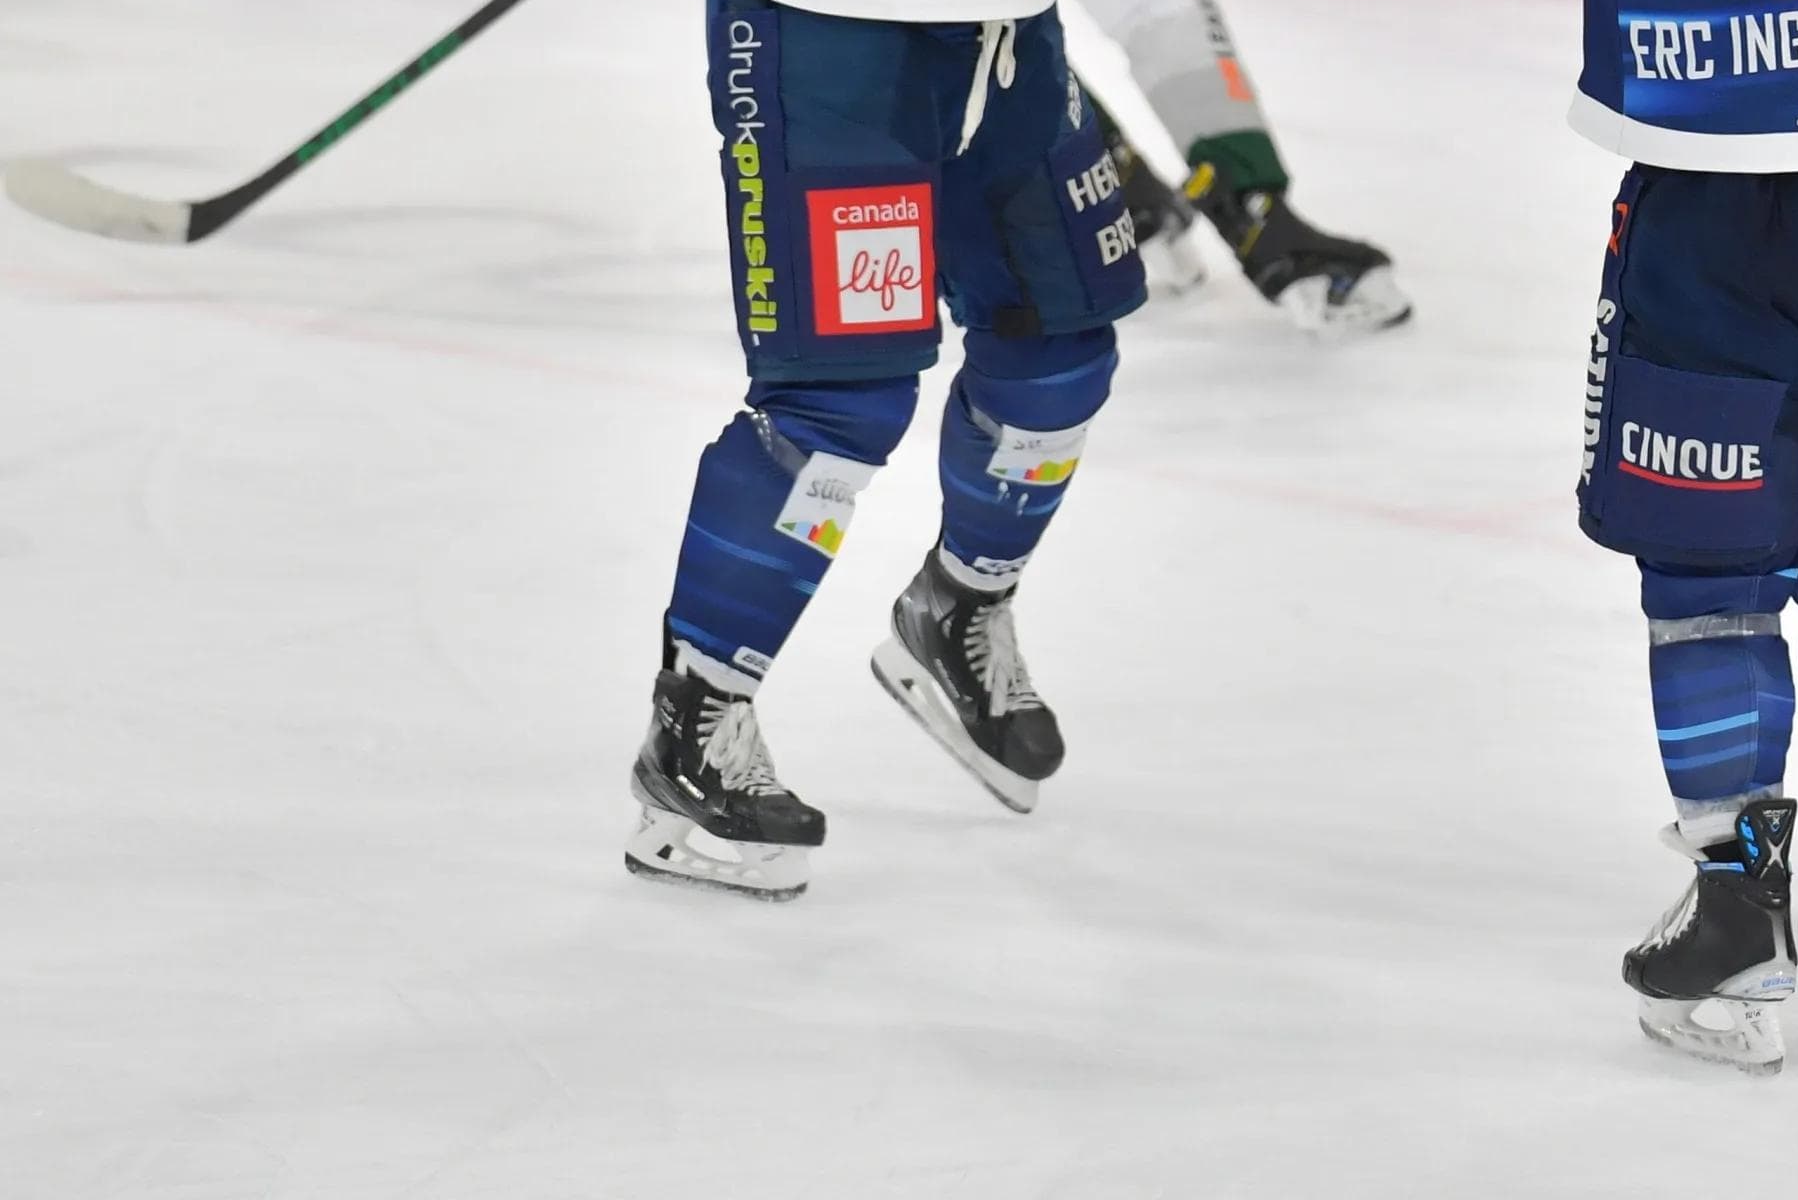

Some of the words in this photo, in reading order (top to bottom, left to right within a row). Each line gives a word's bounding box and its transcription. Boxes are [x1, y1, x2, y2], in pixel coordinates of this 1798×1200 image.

[1630, 21, 1715, 81] ERC
[832, 196, 919, 225] canada
[838, 249, 923, 312] life
[1622, 421, 1763, 481] CINQUE
